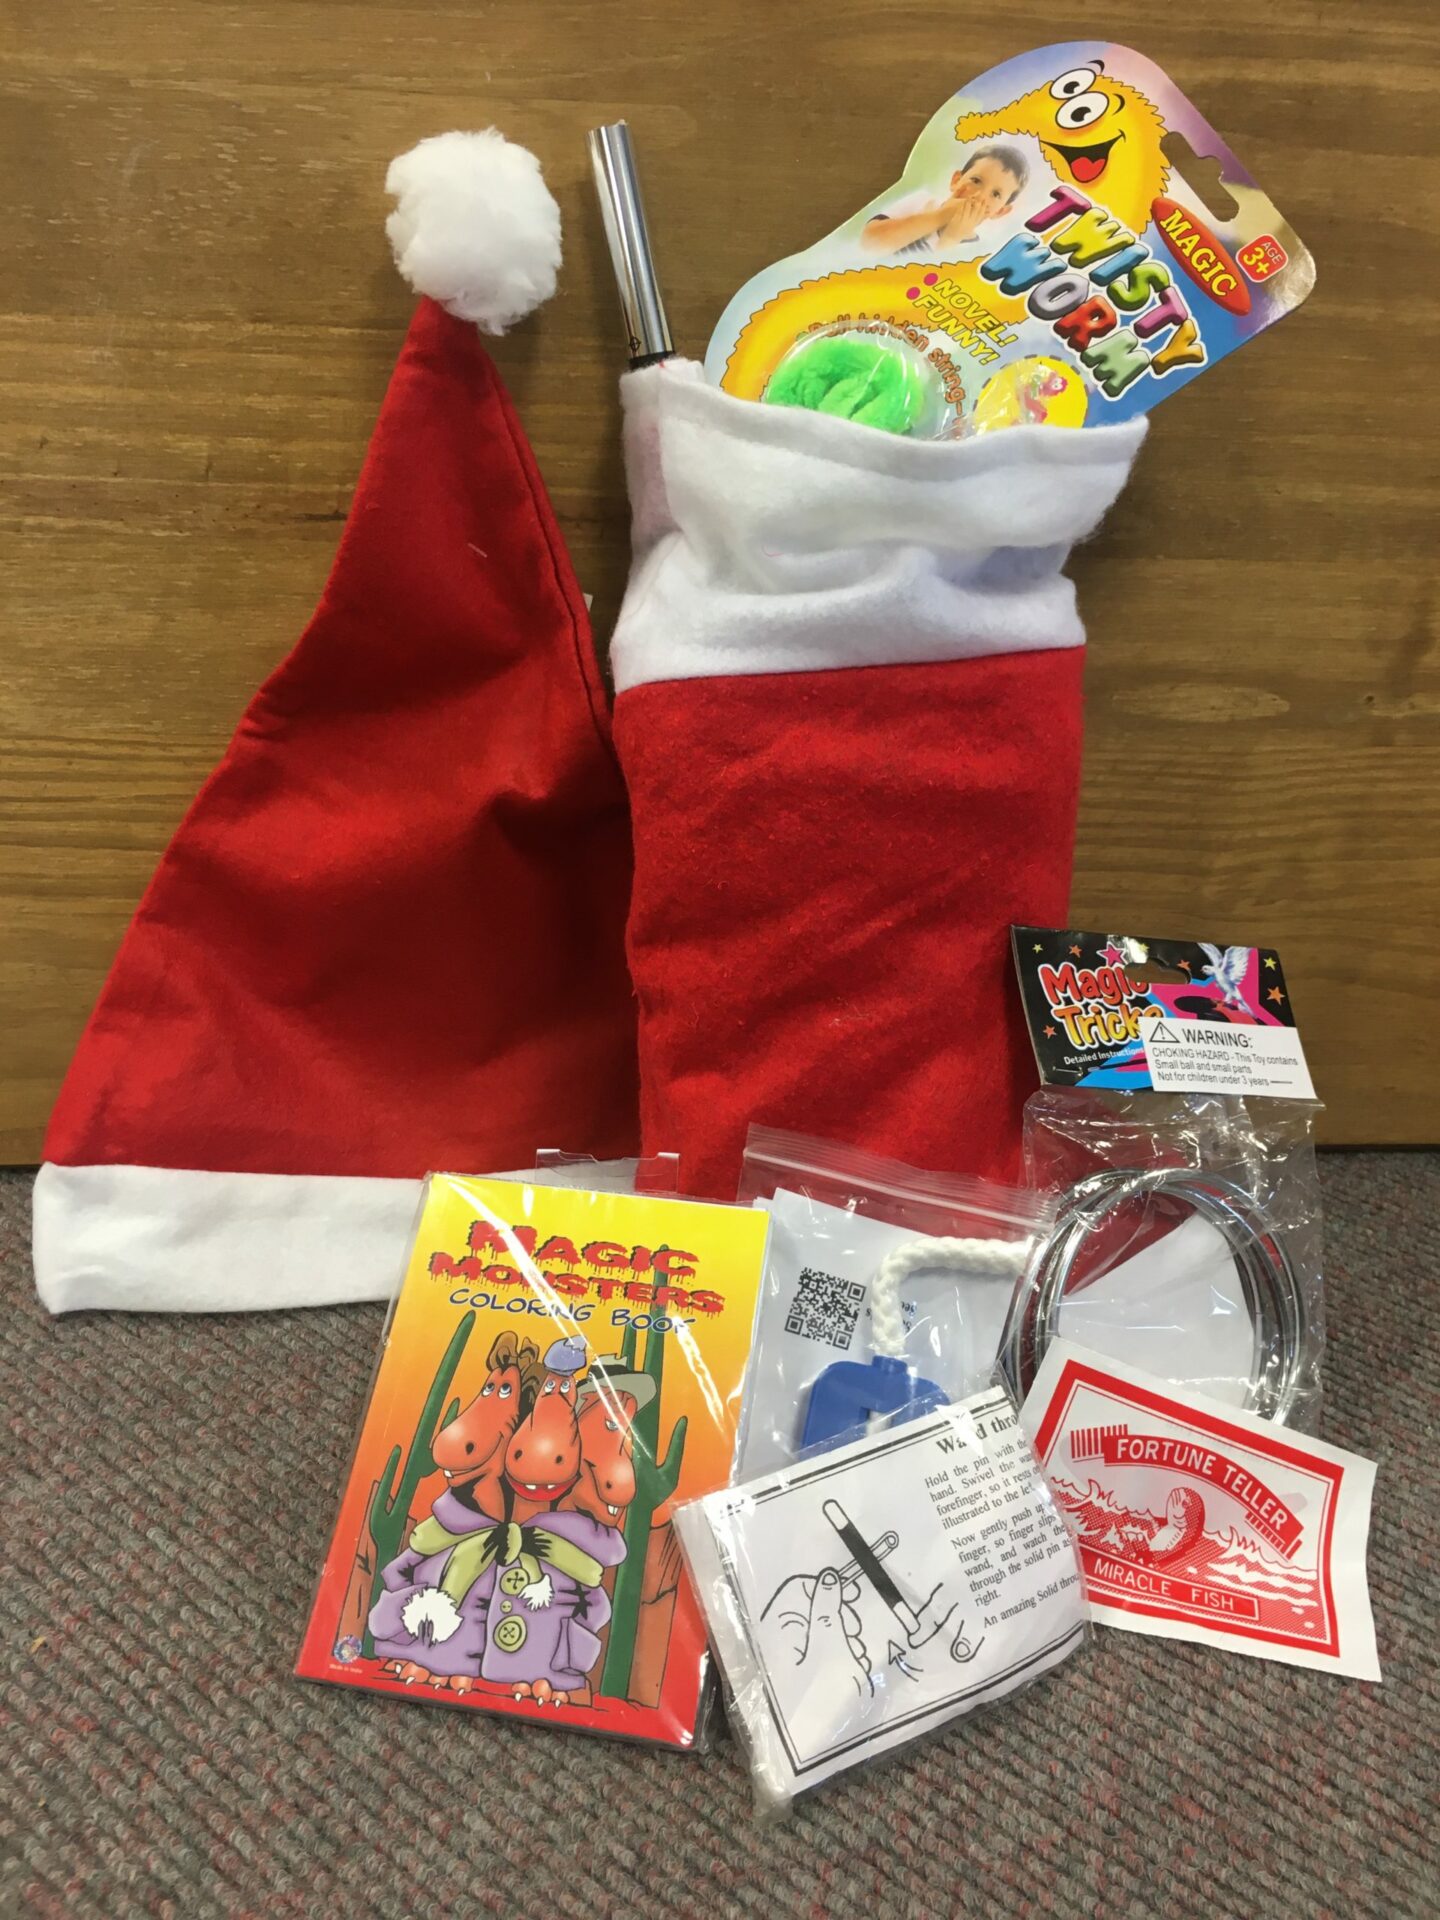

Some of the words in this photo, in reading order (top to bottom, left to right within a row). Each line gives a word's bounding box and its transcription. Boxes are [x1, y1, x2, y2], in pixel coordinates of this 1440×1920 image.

[1159, 209, 1237, 297] MAGIC
[1243, 247, 1270, 275] 3+
[1261, 240, 1281, 265] AGE
[1024, 184, 1206, 376] TWISTY
[912, 294, 1000, 365] FUNNY!
[933, 278, 1018, 347] NOVEL!
[980, 232, 1151, 398] WORM
[1063, 1052, 1098, 1065] Detailed
[1152, 1047, 1195, 1059] CHOKING
[1196, 1049, 1230, 1061] HAZARD
[1235, 1052, 1252, 1062] This
[1252, 1053, 1265, 1065] Toy
[1266, 1055, 1298, 1066] contains
[1182, 1028, 1253, 1048] WARNING:
[1155, 1060, 1179, 1070] Small
[1180, 1060, 1195, 1070] ball
[1196, 1061, 1211, 1071] and
[1212, 1062, 1232, 1072] small
[1233, 1063, 1253, 1074] parts
[1158, 1072, 1173, 1081] Not
[1174, 1072, 1186, 1081] for
[1188, 1073, 1218, 1083] children
[1219, 1074, 1240, 1084] under
[1249, 1076, 1269, 1087] years
[466, 1220, 699, 1284] MAGIC
[936, 1423, 988, 1454] Wad
[925, 1470, 949, 1488] Hold
[953, 1465, 968, 1477] the
[973, 1456, 990, 1471] pin
[994, 1444, 1015, 1459] with
[929, 1484, 957, 1502] hand.
[961, 1468, 995, 1488] Swivel
[999, 1461, 1015, 1473] the
[1117, 1438, 1217, 1475] FORTUNE
[1225, 1465, 1288, 1531] TELLER
[936, 1489, 987, 1516] forefinger,
[989, 1484, 1001, 1494] so
[1002, 1477, 1011, 1487] it
[1012, 1470, 1032, 1483] rests
[942, 1500, 991, 1530] illustrated
[992, 1498, 1002, 1508] to
[1004, 1489, 1019, 1503] the
[951, 1533, 976, 1550] Now
[980, 1520, 1008, 1540] gently
[1012, 1507, 1033, 1526] push
[959, 1545, 990, 1563] finger,
[994, 1539, 1005, 1548] so
[1009, 1523, 1034, 1541] finger
[964, 1558, 993, 1577] wand,
[1000, 1546, 1017, 1561] and
[1023, 1532, 1047, 1550] watch
[969, 1569, 1006, 1592] through
[1008, 1562, 1021, 1575] the
[1024, 1548, 1044, 1567] solid
[1047, 1543, 1061, 1558] pin
[974, 1589, 1001, 1607] right.
[984, 1615, 998, 1628] An
[1000, 1596, 1037, 1620] amazing
[1037, 1583, 1059, 1602] Solid
[1094, 1558, 1171, 1597] MIRACLE
[1191, 1588, 1234, 1611] FISH
